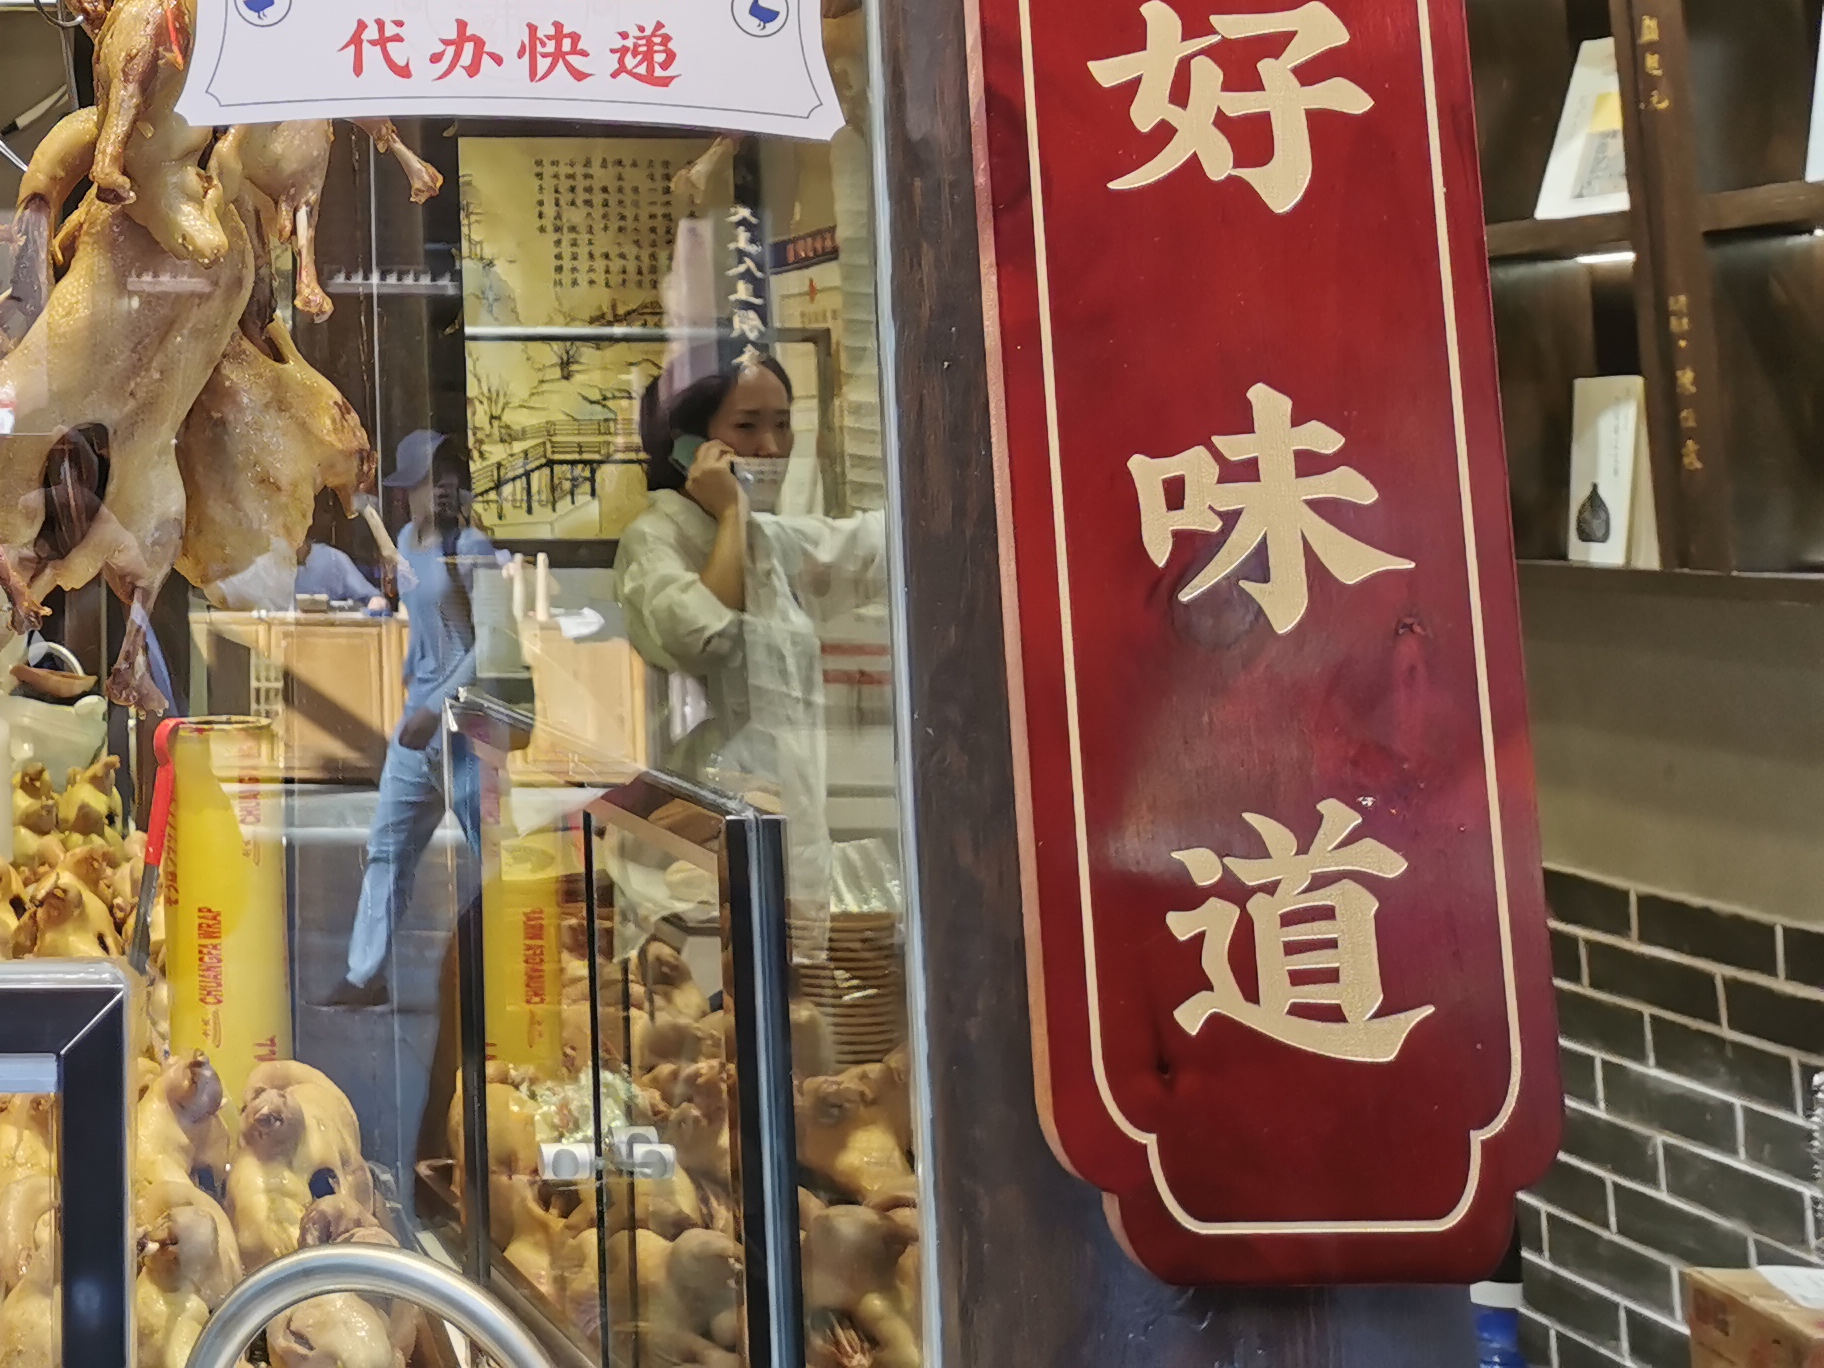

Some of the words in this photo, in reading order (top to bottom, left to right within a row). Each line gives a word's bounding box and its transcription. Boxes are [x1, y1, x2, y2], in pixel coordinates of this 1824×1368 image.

[337, 18, 682, 88] 代办快递
[197, 906, 222, 940] WRAP
[198, 942, 224, 1006] CHUANGFA
